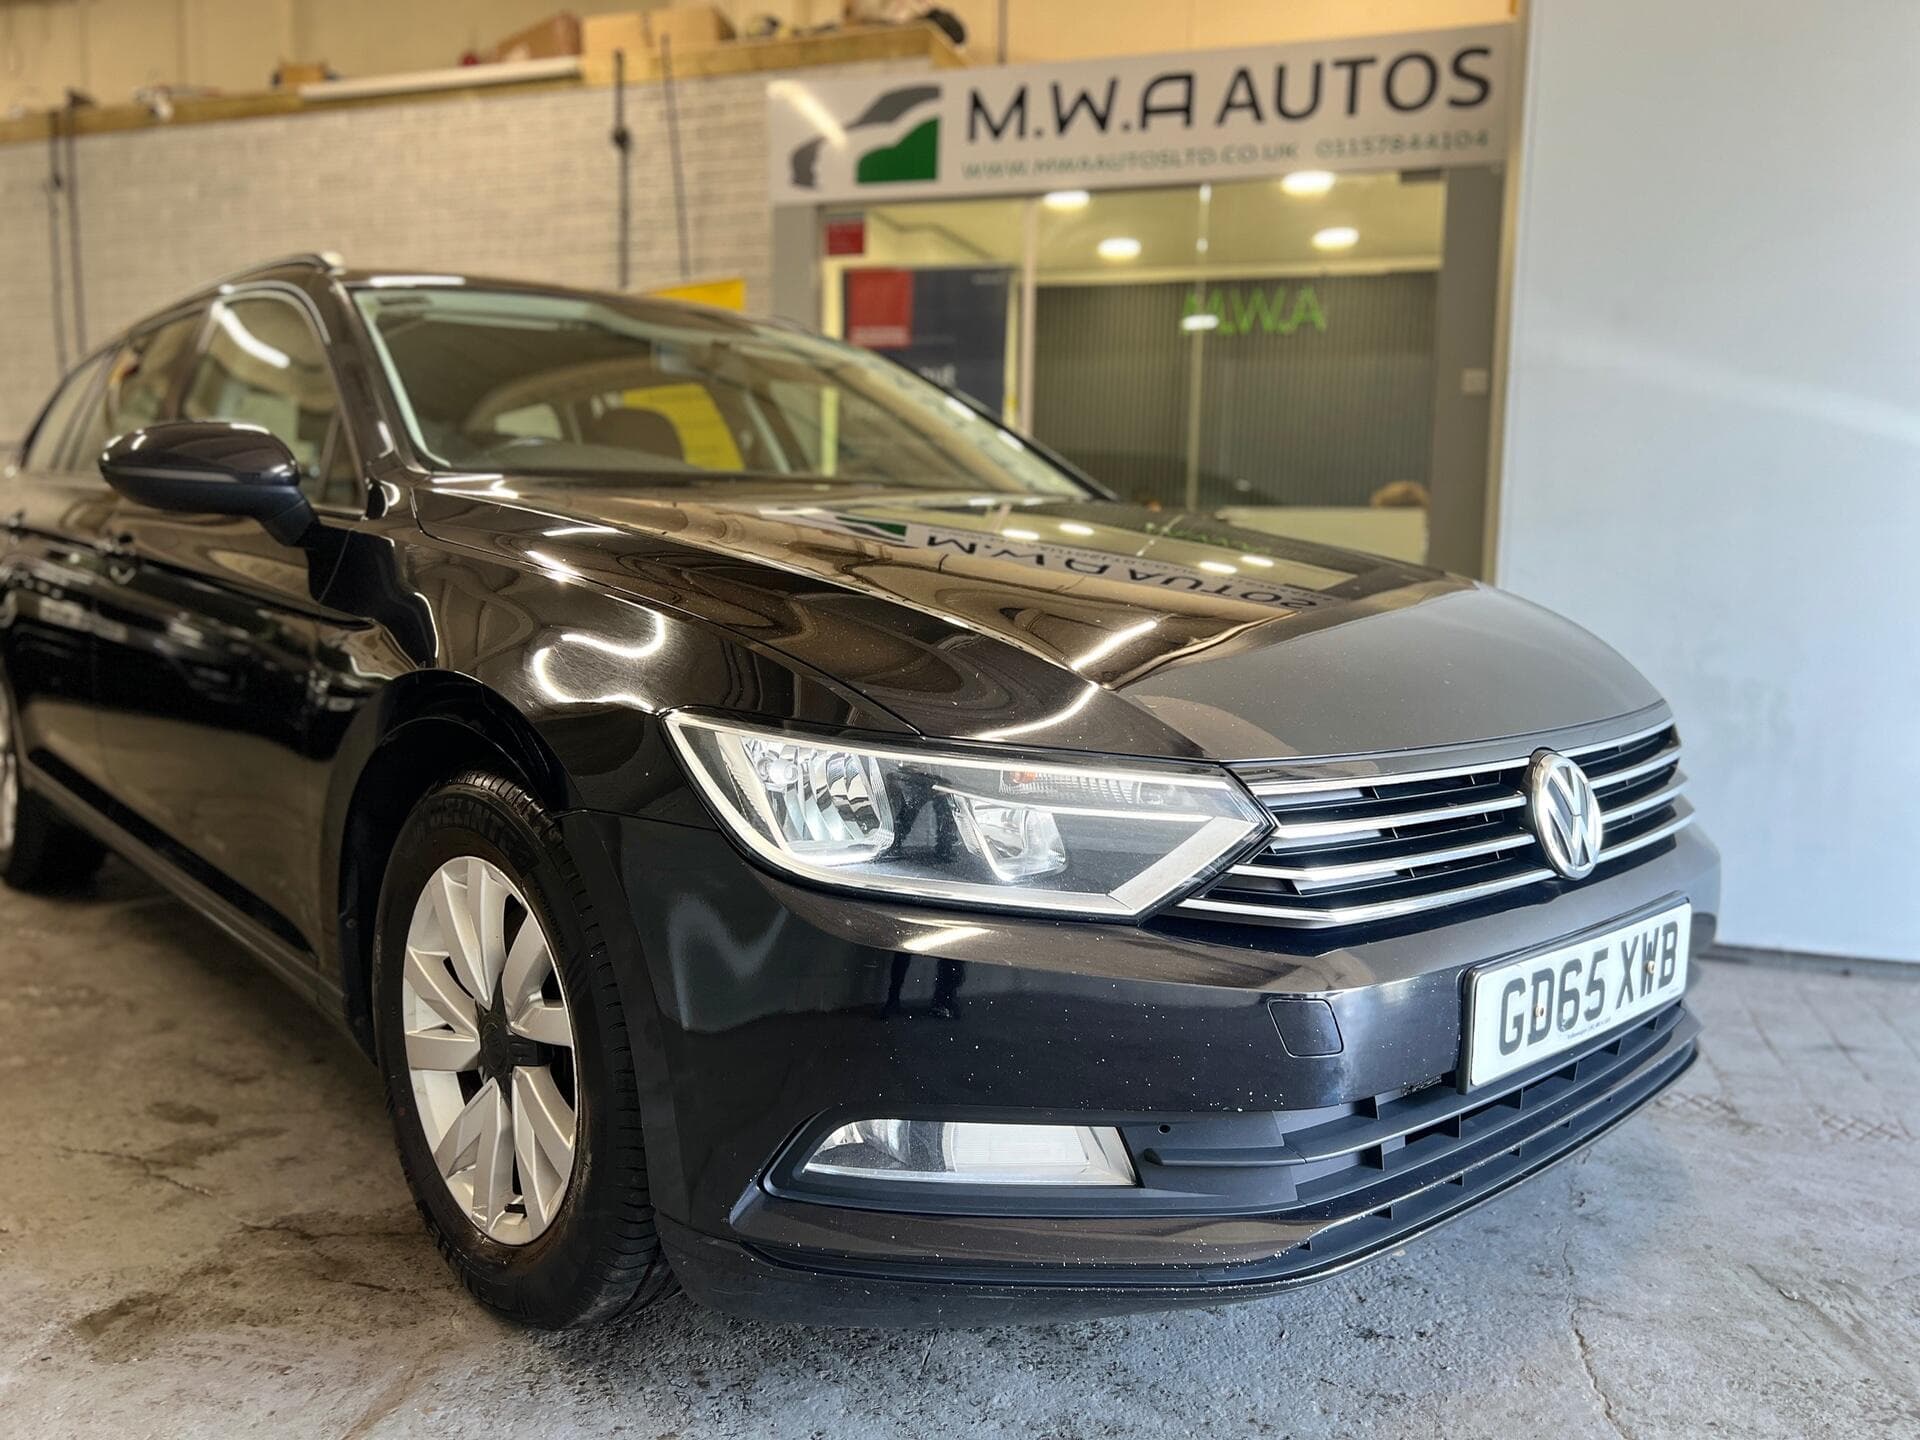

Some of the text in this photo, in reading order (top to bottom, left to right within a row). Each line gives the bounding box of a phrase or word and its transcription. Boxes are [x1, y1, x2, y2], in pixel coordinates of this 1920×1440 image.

[967, 45, 1494, 142] M.W.A AUTOS
[1499, 920, 1679, 1057] GD65 XWB
